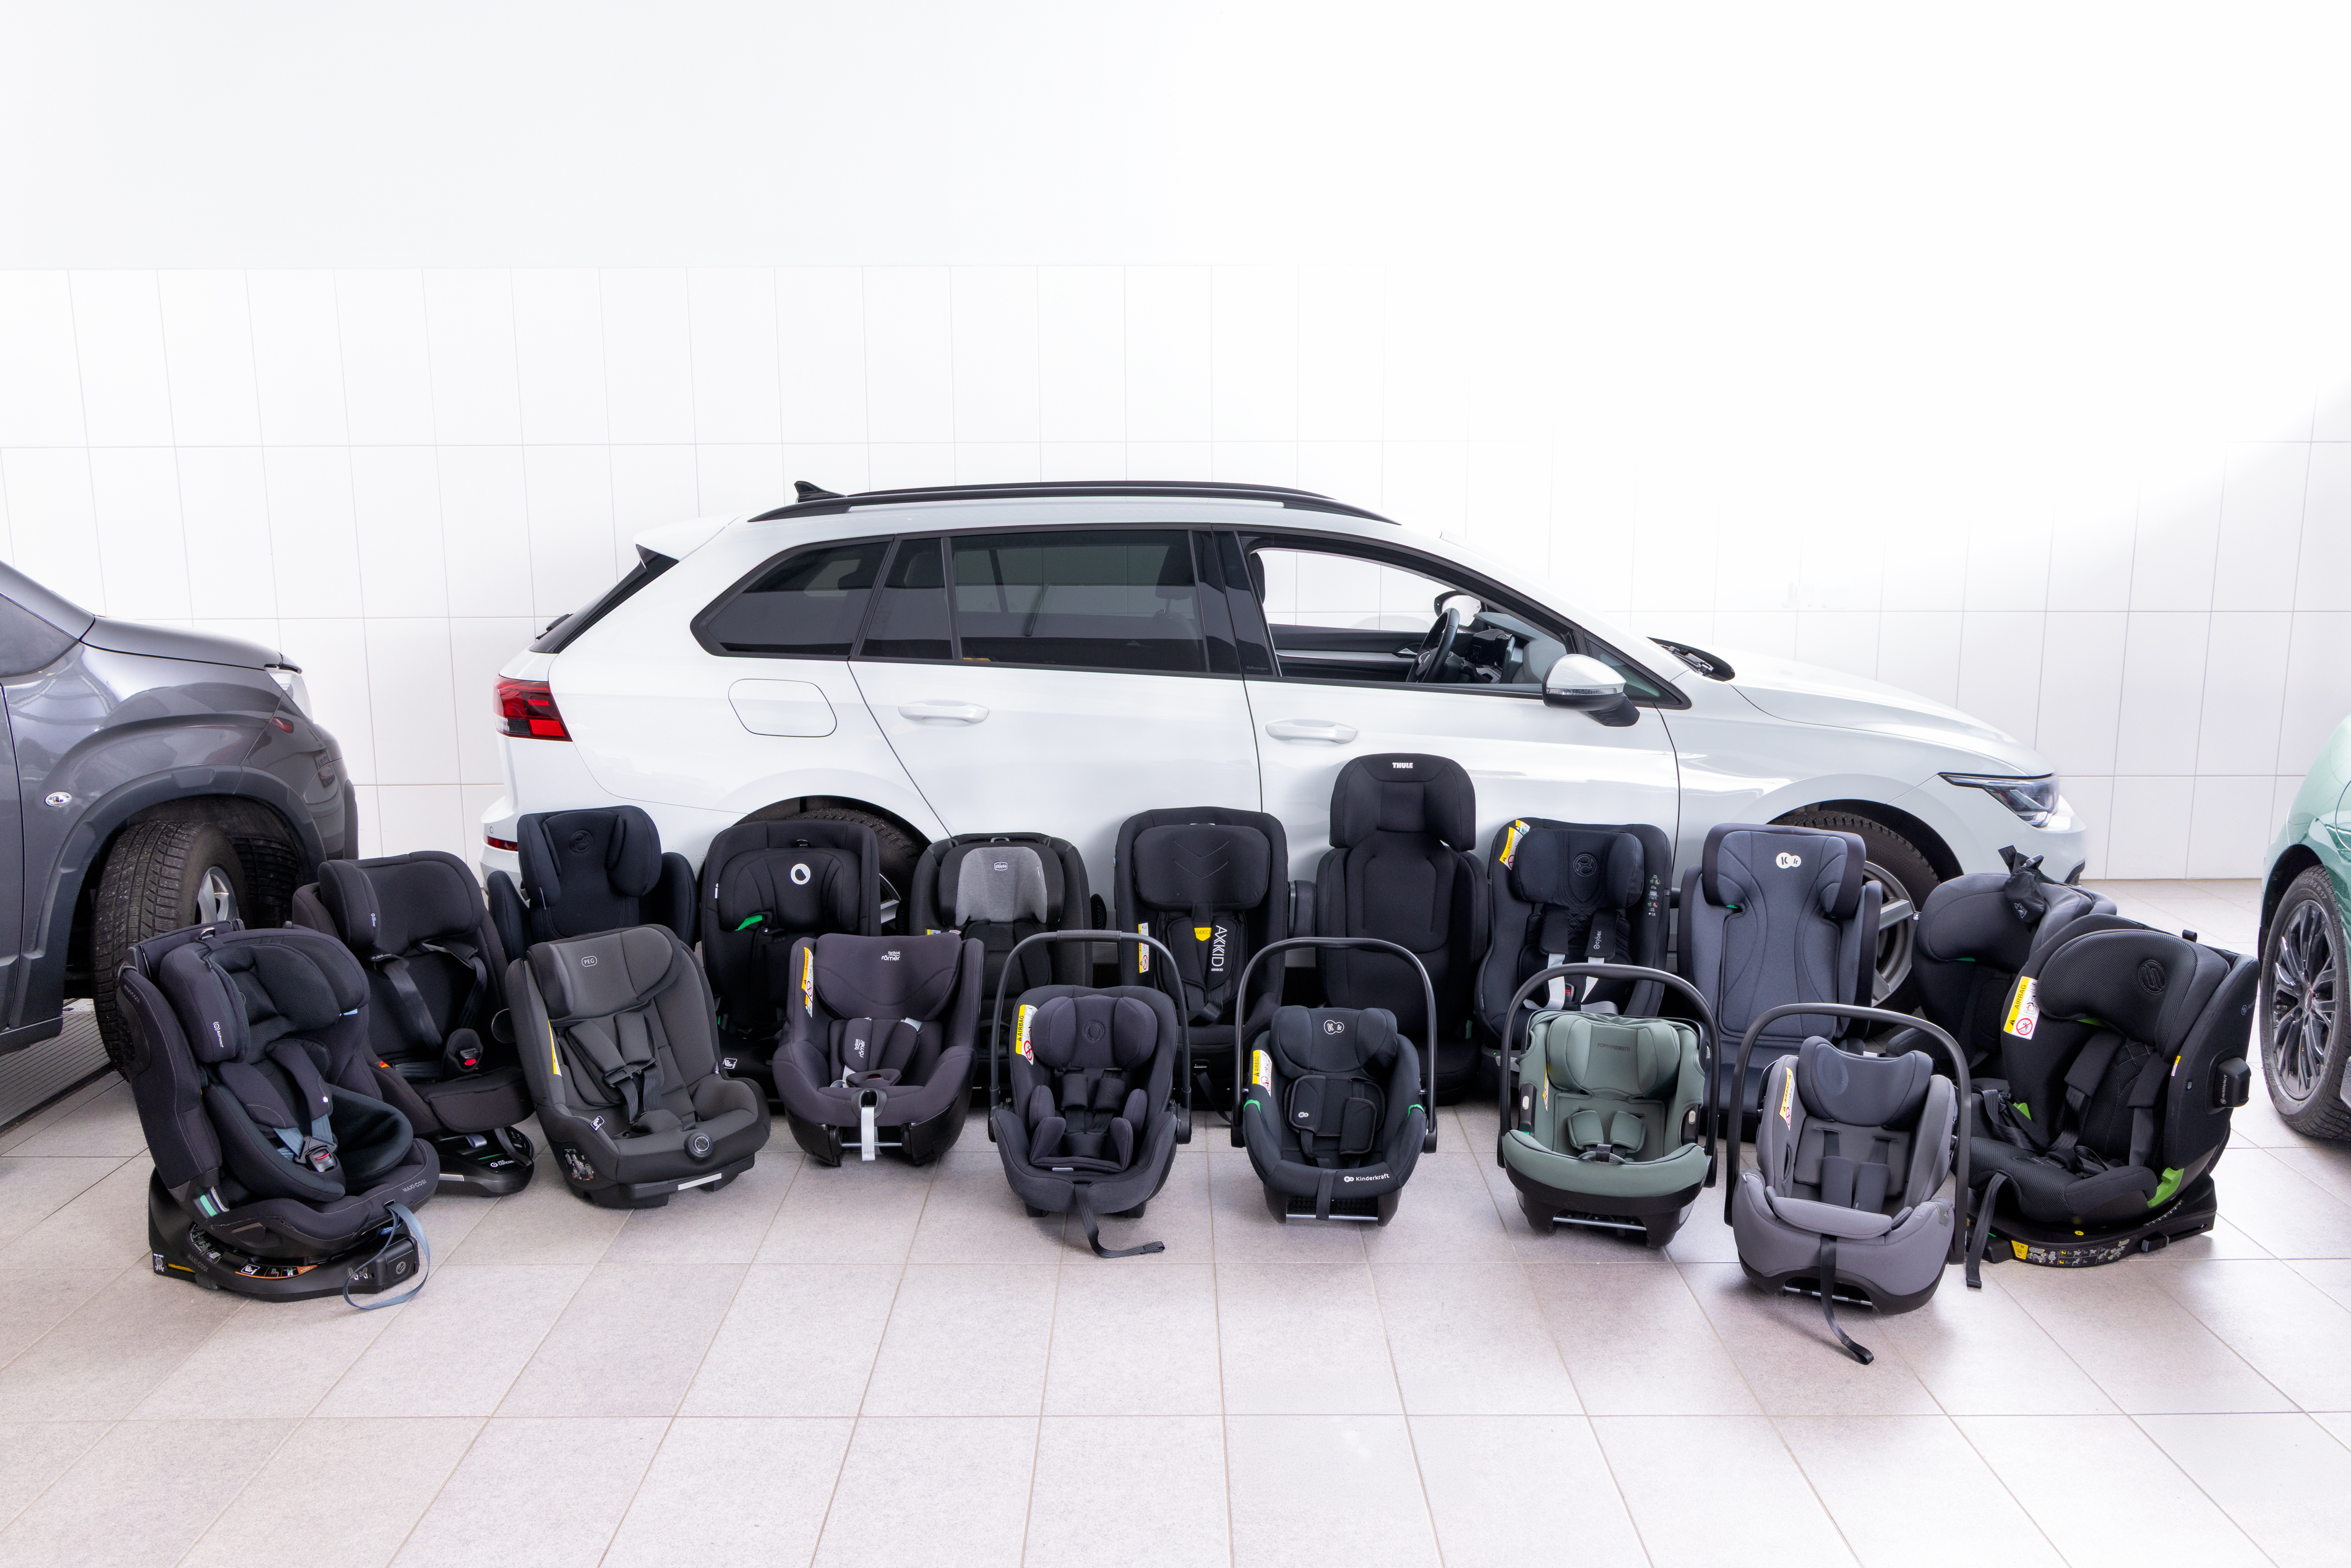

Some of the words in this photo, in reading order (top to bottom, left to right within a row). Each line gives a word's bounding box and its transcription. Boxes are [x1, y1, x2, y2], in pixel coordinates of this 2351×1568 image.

[2316, 886, 2327, 899] R17
[1594, 930, 1602, 945] cybex
[1212, 925, 1227, 967] AXKID
[2014, 984, 2026, 1009] AIRBAG
[1597, 1042, 1630, 1052] FOPPAPEDRETTI
[1356, 1173, 1390, 1181] Kinderkraft
